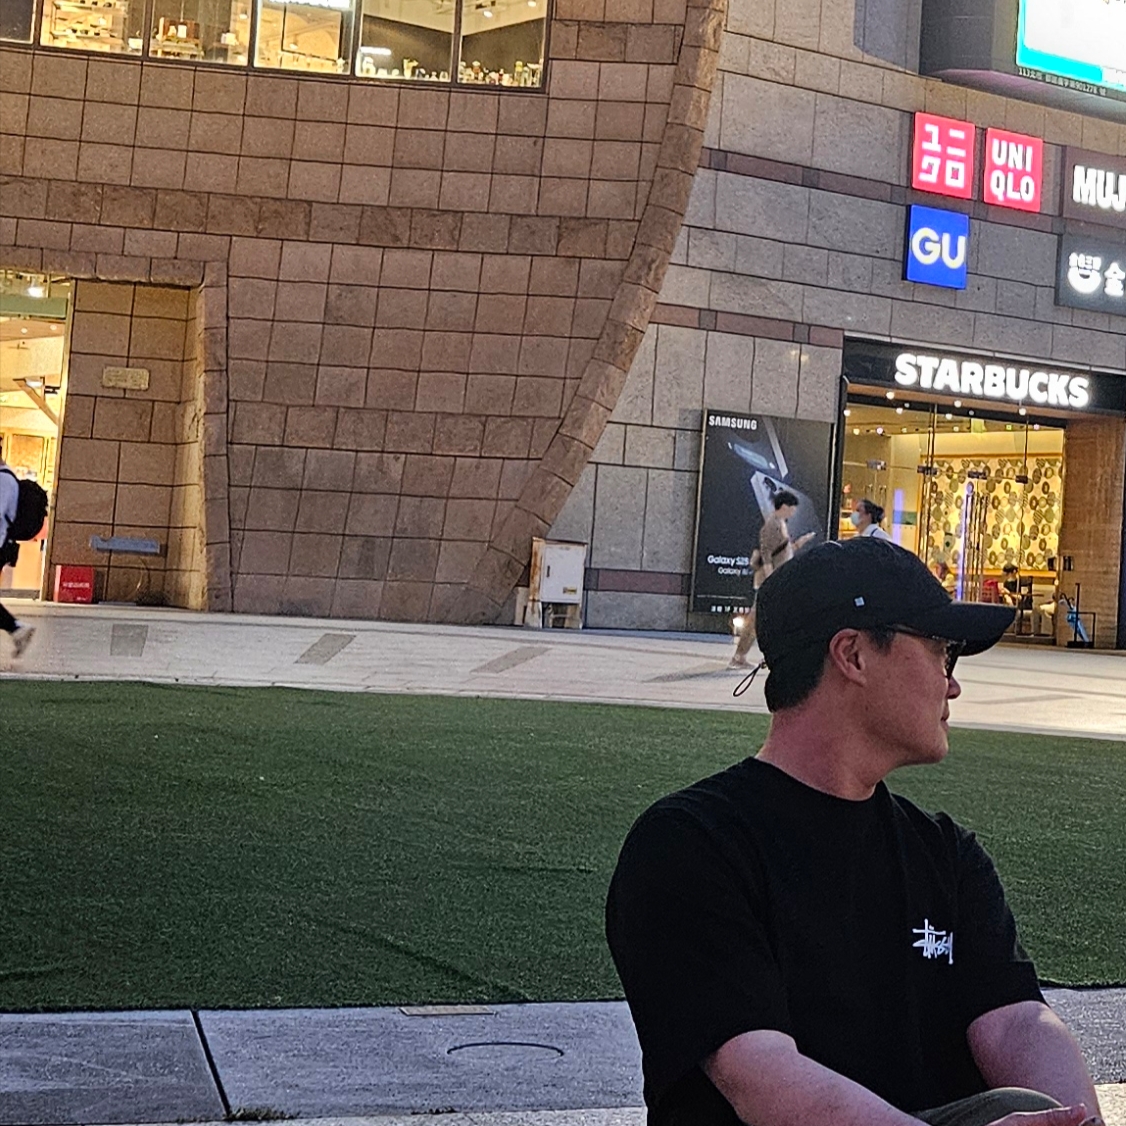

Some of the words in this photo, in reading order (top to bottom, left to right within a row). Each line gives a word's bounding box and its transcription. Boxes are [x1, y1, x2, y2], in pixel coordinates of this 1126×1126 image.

[992, 138, 1033, 172] UNI
[990, 170, 1035, 202] QLO
[912, 227, 966, 269] GU
[895, 353, 1089, 408] STARBUCKS
[709, 415, 757, 430] SAMSUNG
[707, 555, 735, 567] Galaxy
